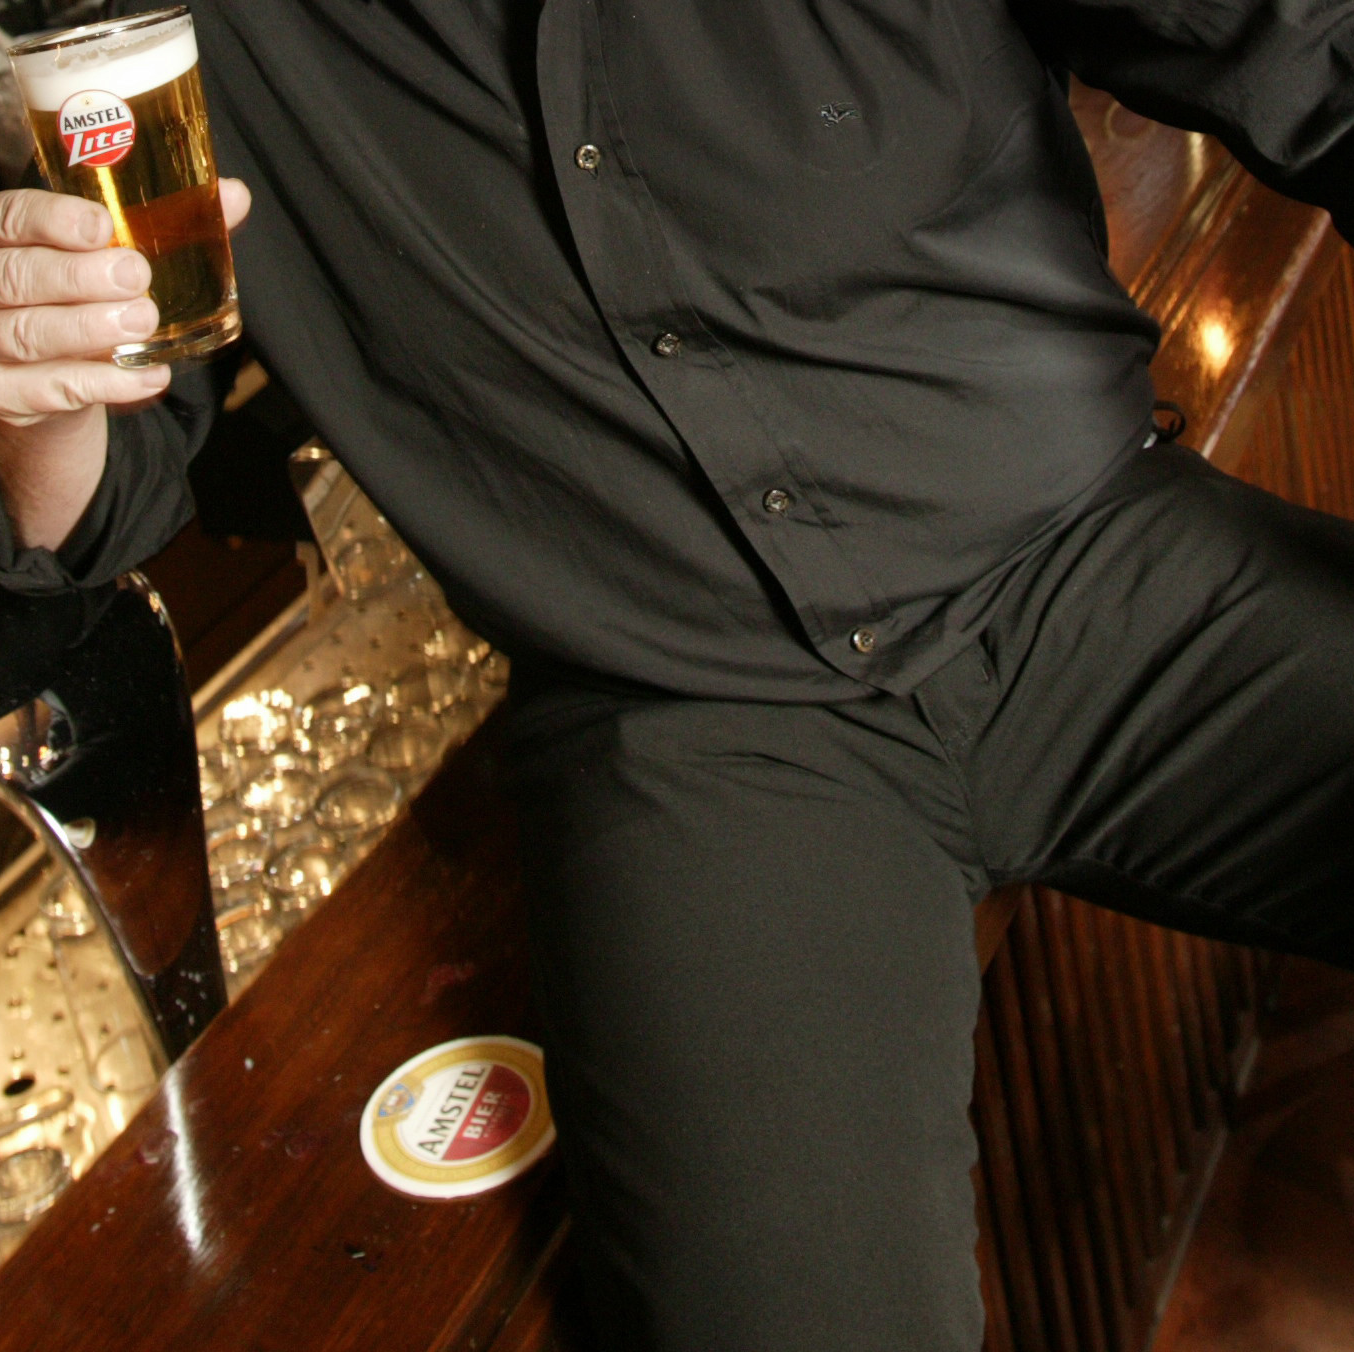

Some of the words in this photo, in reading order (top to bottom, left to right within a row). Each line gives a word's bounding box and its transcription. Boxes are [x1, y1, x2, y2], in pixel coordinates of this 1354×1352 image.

[63, 106, 125, 131] AMSTEL
[68, 128, 134, 167] Lite
[417, 1064, 486, 1156] AMSTEL
[461, 1090, 503, 1140] BIER
